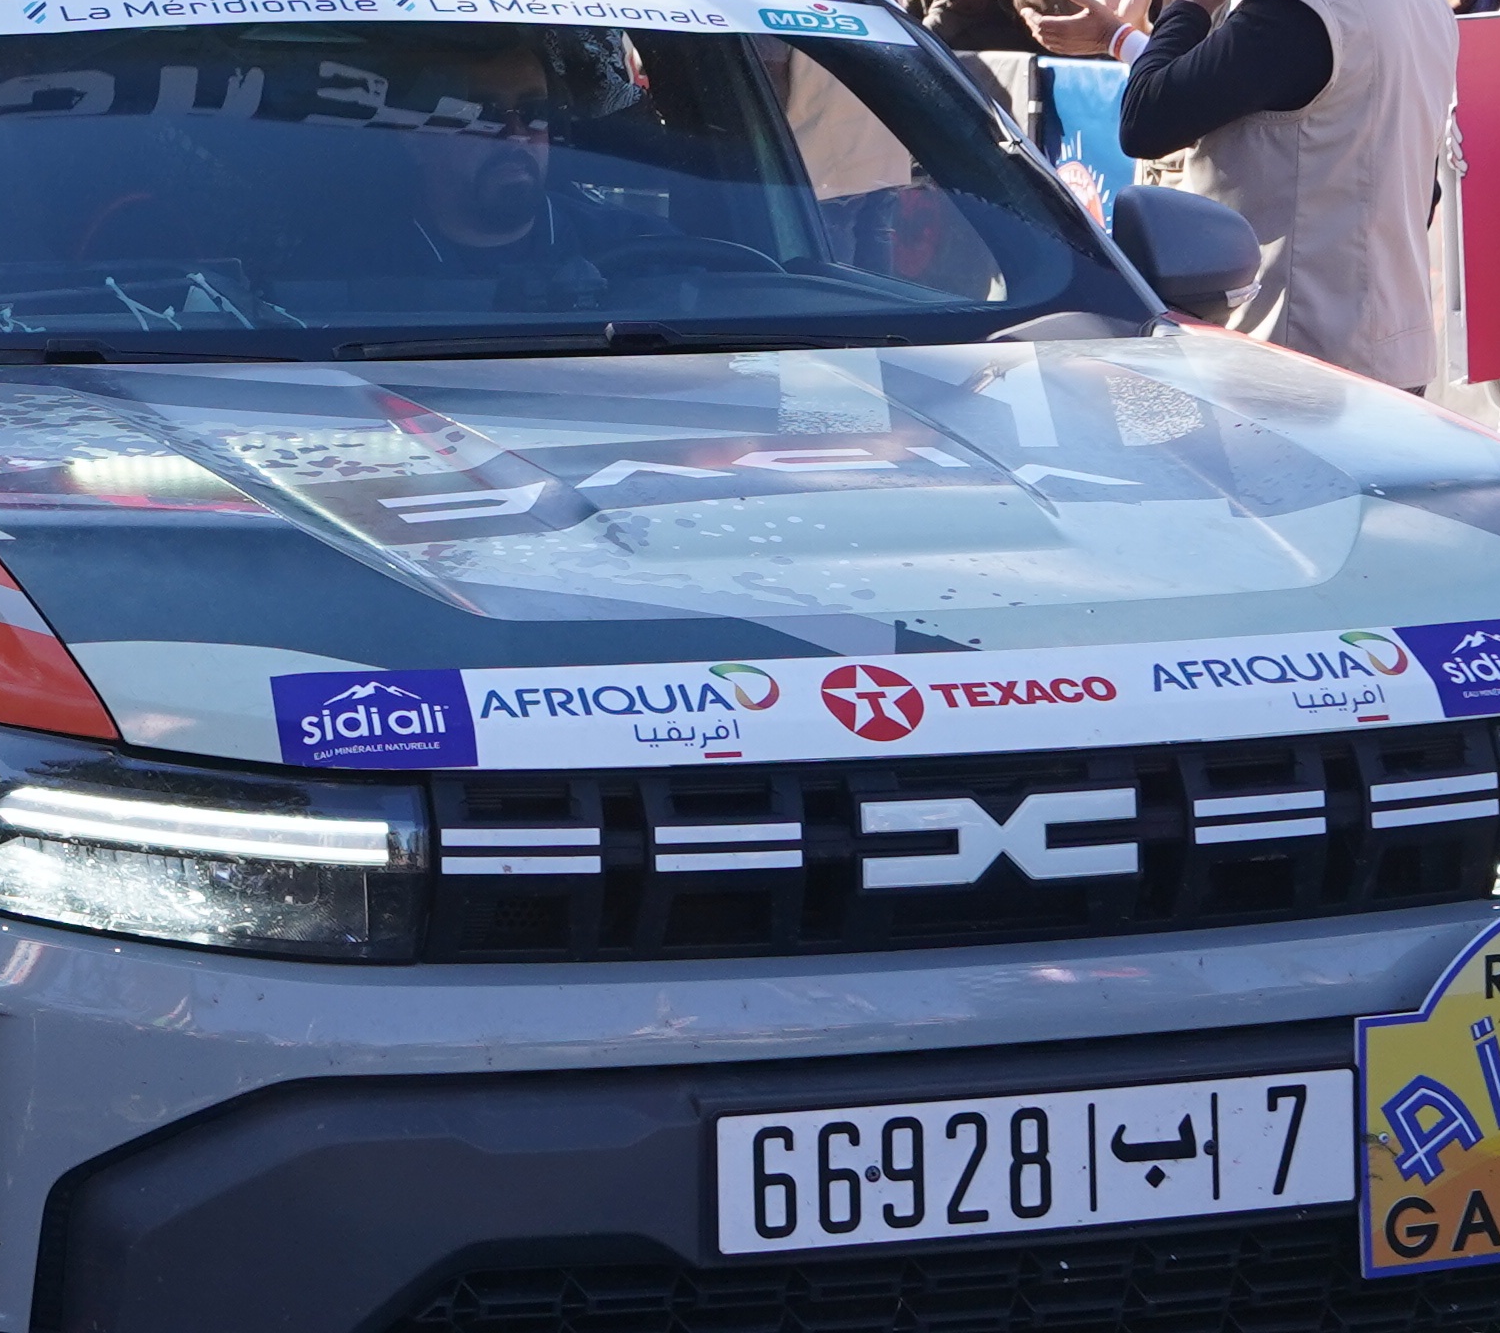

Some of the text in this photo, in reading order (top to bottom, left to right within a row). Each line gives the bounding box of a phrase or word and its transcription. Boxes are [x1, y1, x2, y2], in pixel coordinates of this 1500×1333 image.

[61, 5, 112, 22] La
[766, 11, 861, 32] MDJS
[1153, 651, 1374, 692] AFRIQUIA
[479, 681, 736, 720] AFRIQUIA
[930, 675, 1117, 710] TEXACO
[302, 703, 447, 745] sidi ali
[1266, 1083, 1307, 1196] 7
[752, 1106, 1052, 1240] 66928
